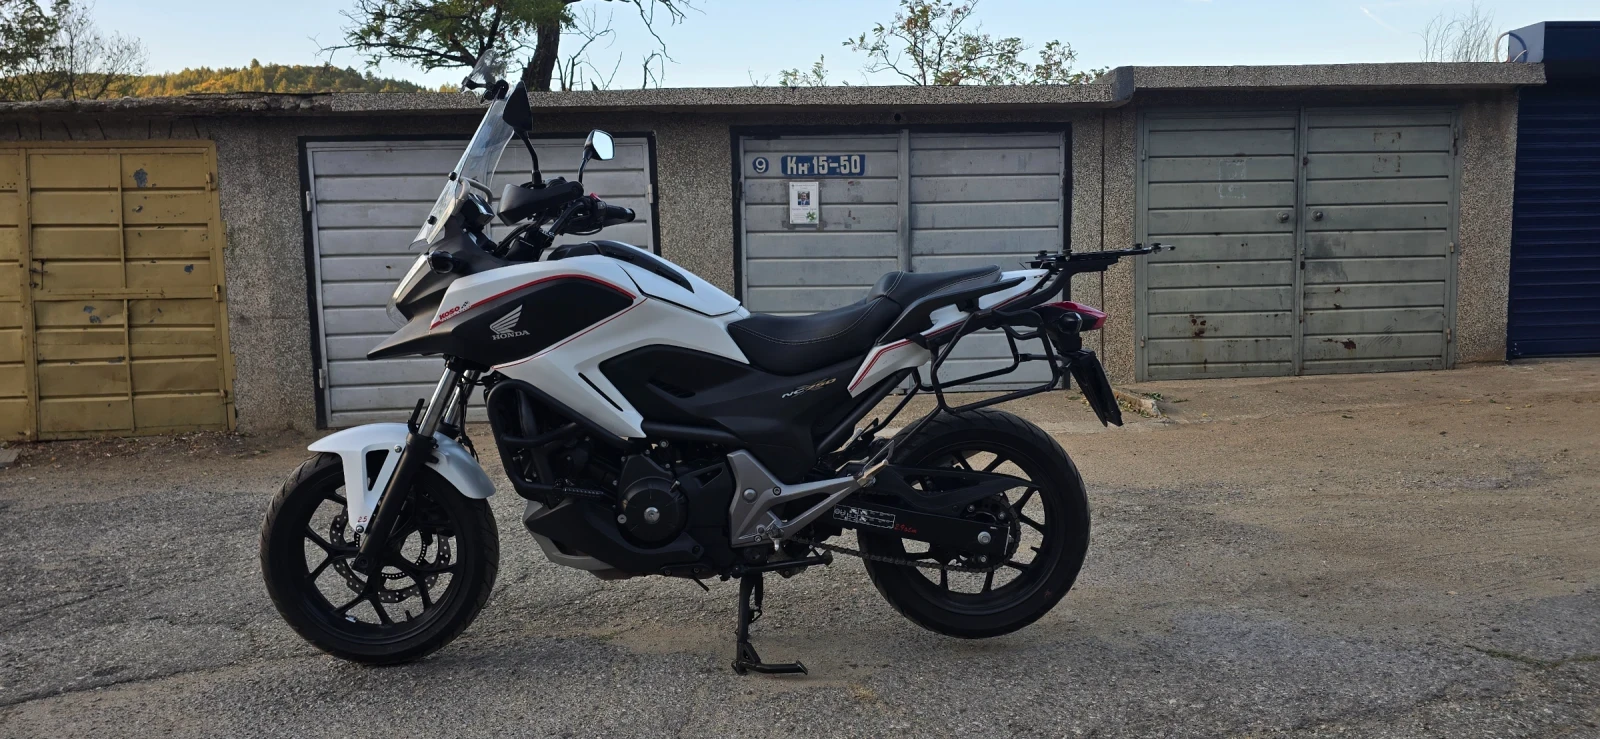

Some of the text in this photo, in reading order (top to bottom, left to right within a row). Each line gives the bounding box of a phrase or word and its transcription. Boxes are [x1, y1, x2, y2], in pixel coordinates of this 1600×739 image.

[755, 158, 767, 173] 9
[812, 155, 861, 174] 15-50
[439, 305, 460, 320] KOSO
[492, 329, 530, 340] HONDA
